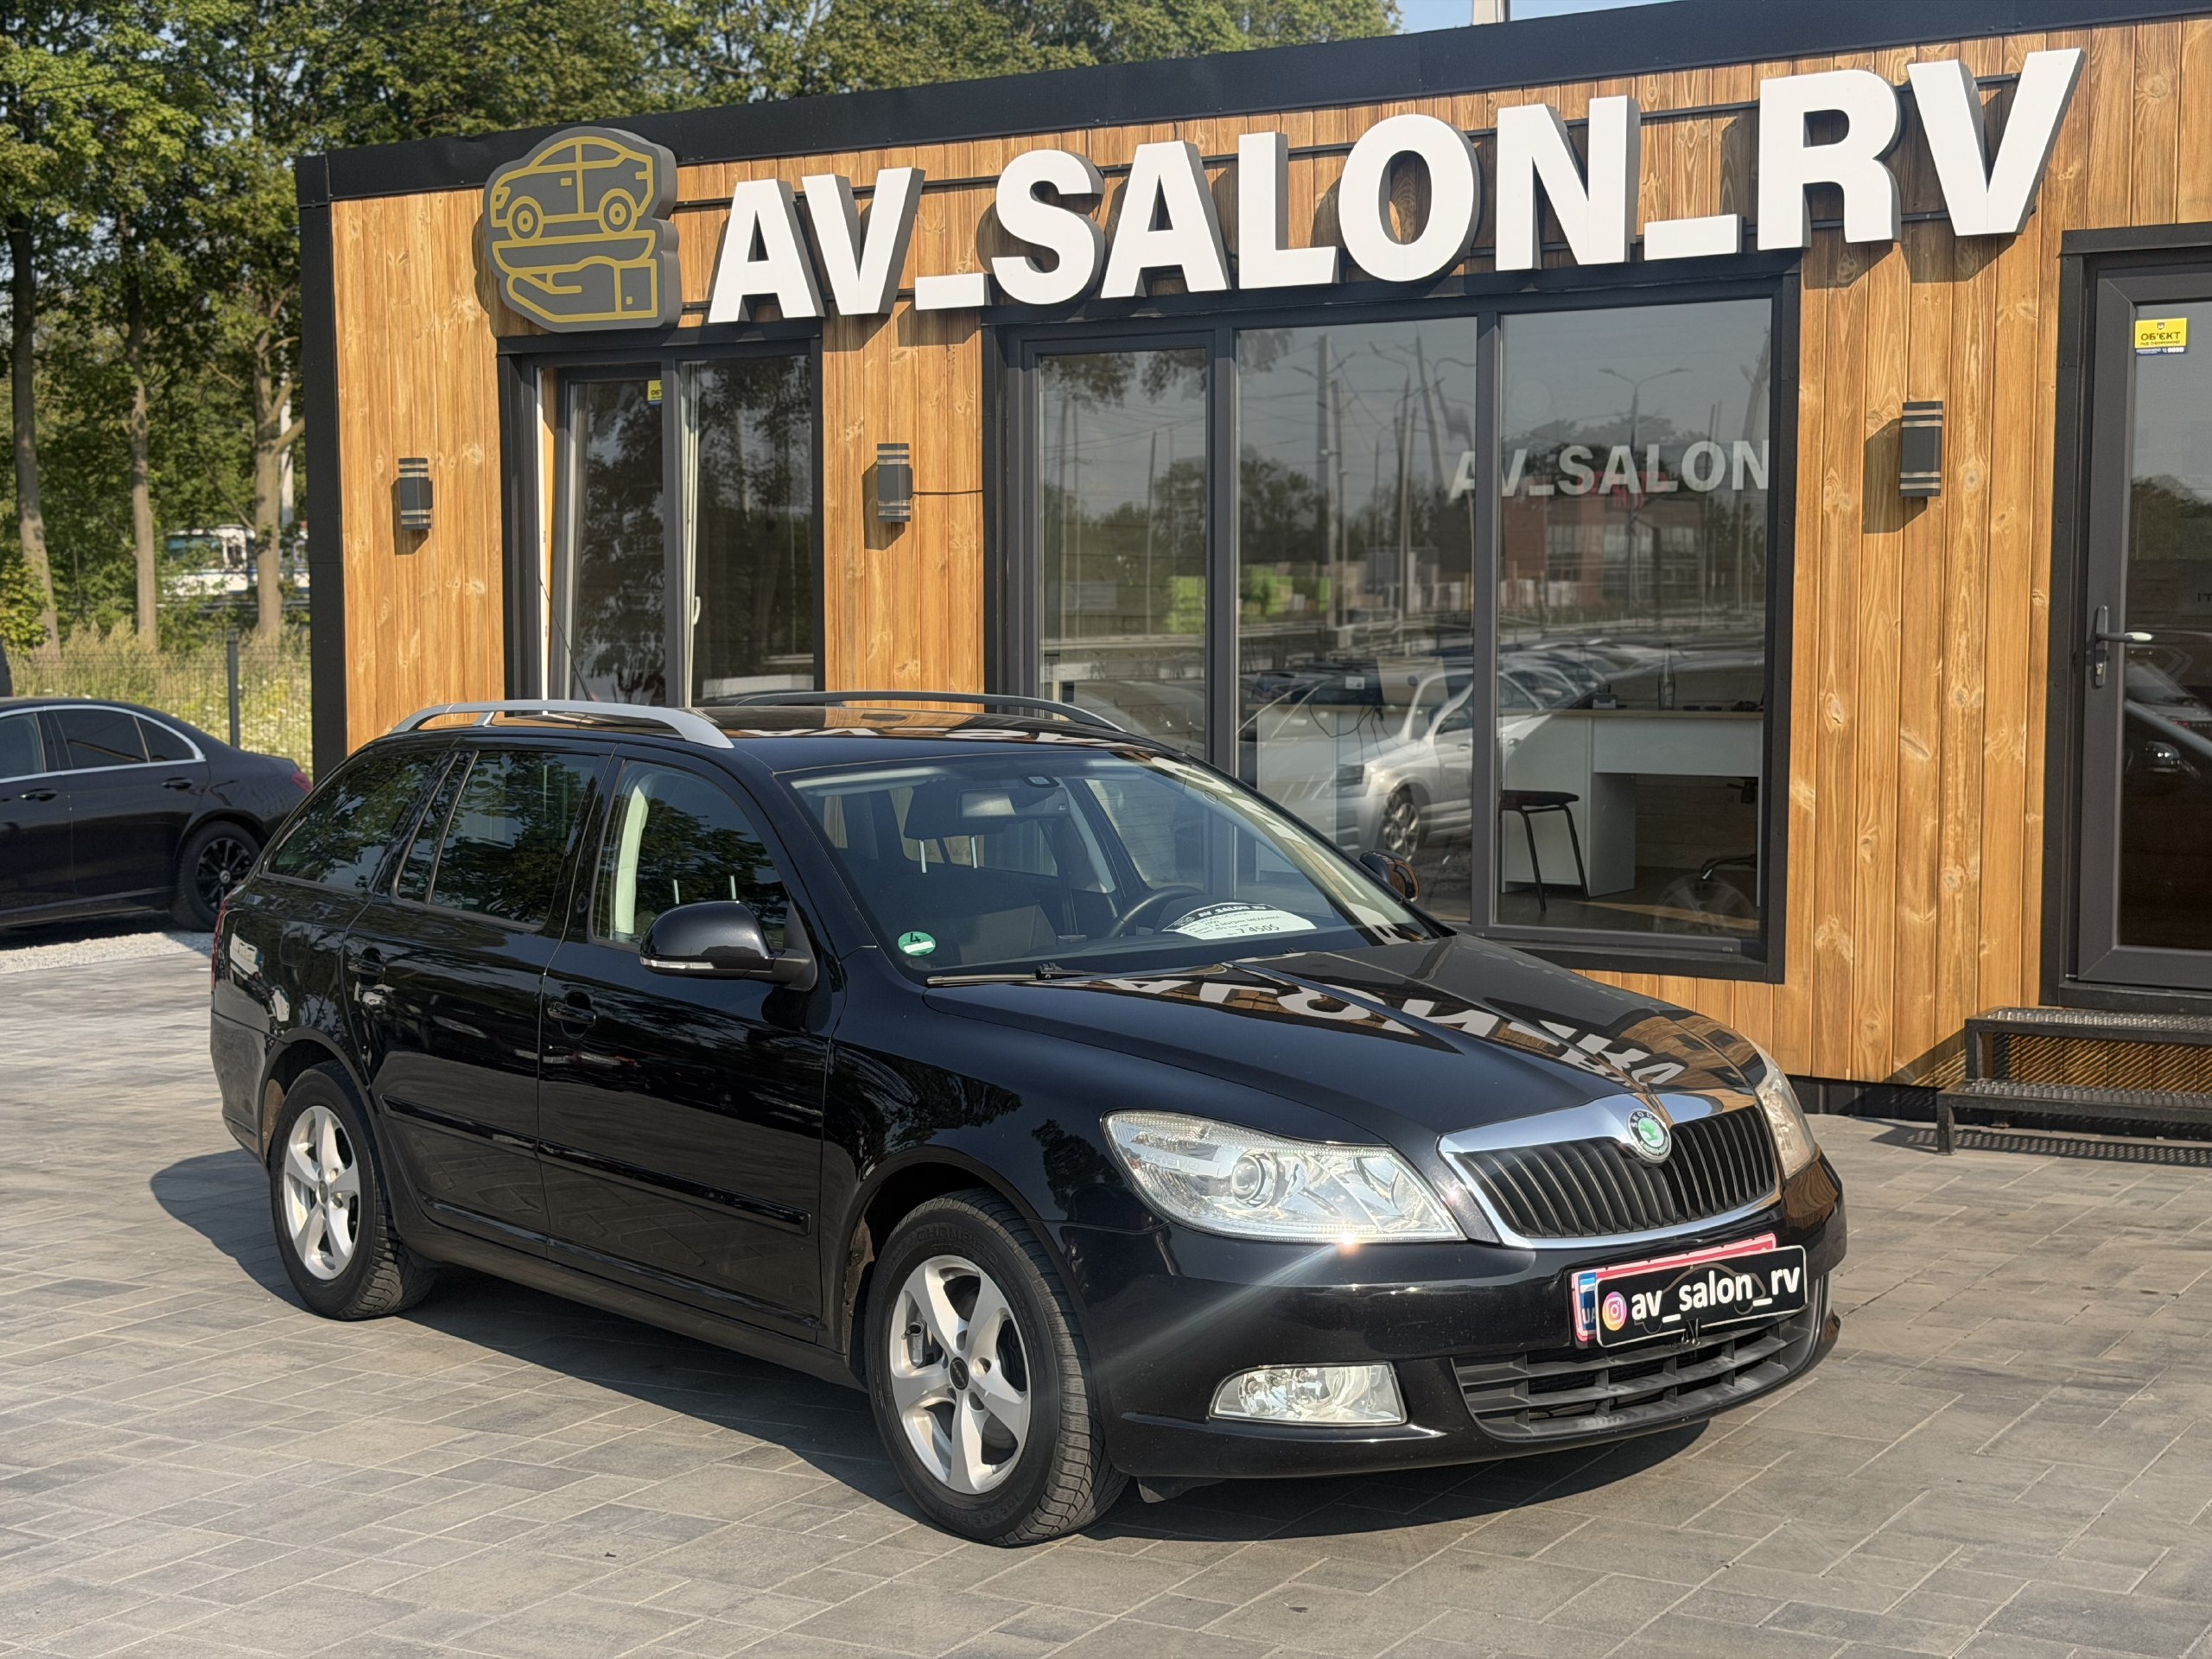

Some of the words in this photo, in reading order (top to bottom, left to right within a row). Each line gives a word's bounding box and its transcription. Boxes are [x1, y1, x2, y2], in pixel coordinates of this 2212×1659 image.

[707, 47, 2084, 325] AV_SALON_RV
[2140, 331, 2181, 340] ОБ'ЄКТ
[910, 932, 921, 943] 4
[1631, 1266, 1801, 1324] av_salon_rv
